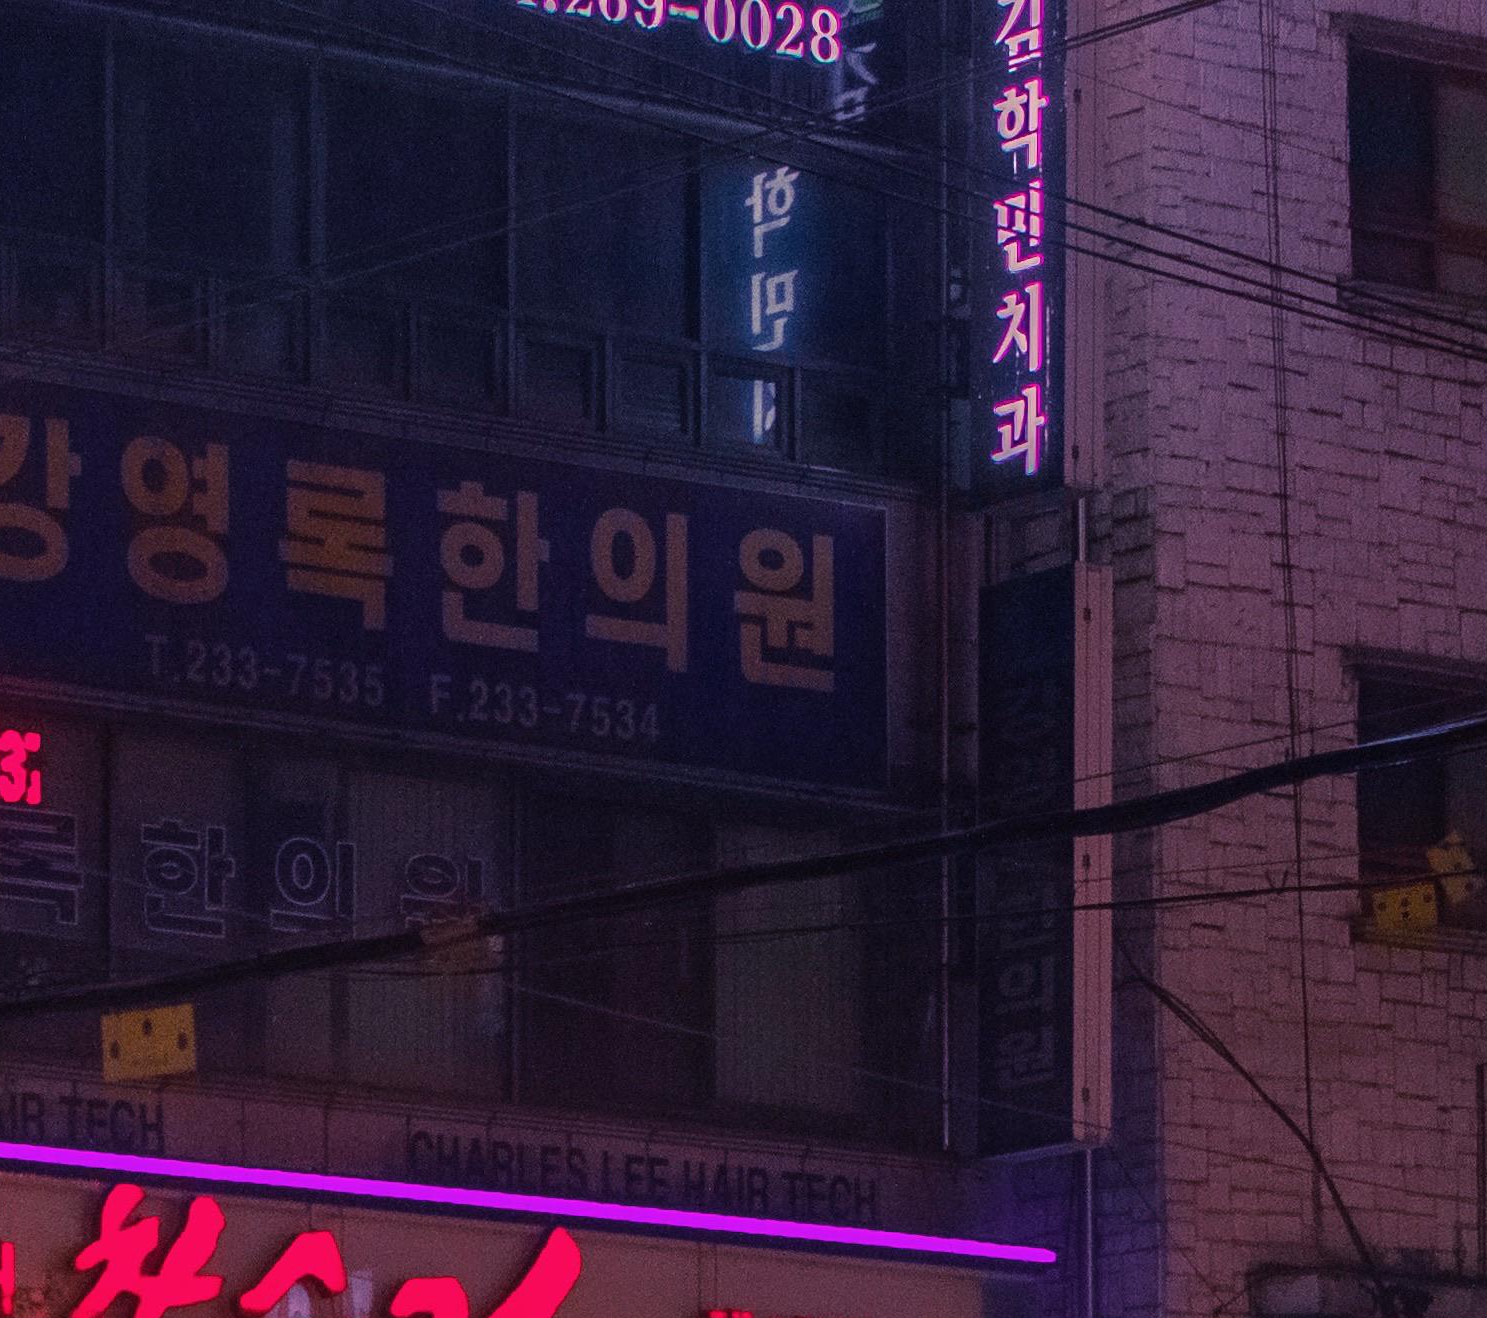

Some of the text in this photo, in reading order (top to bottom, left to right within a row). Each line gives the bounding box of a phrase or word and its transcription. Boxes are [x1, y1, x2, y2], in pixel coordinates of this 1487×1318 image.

[145, 633, 386, 708] T.233-7535
[66, 1098, 165, 1158] TECH
[408, 1131, 879, 1222] CHARLES LEE HAIR TECH
